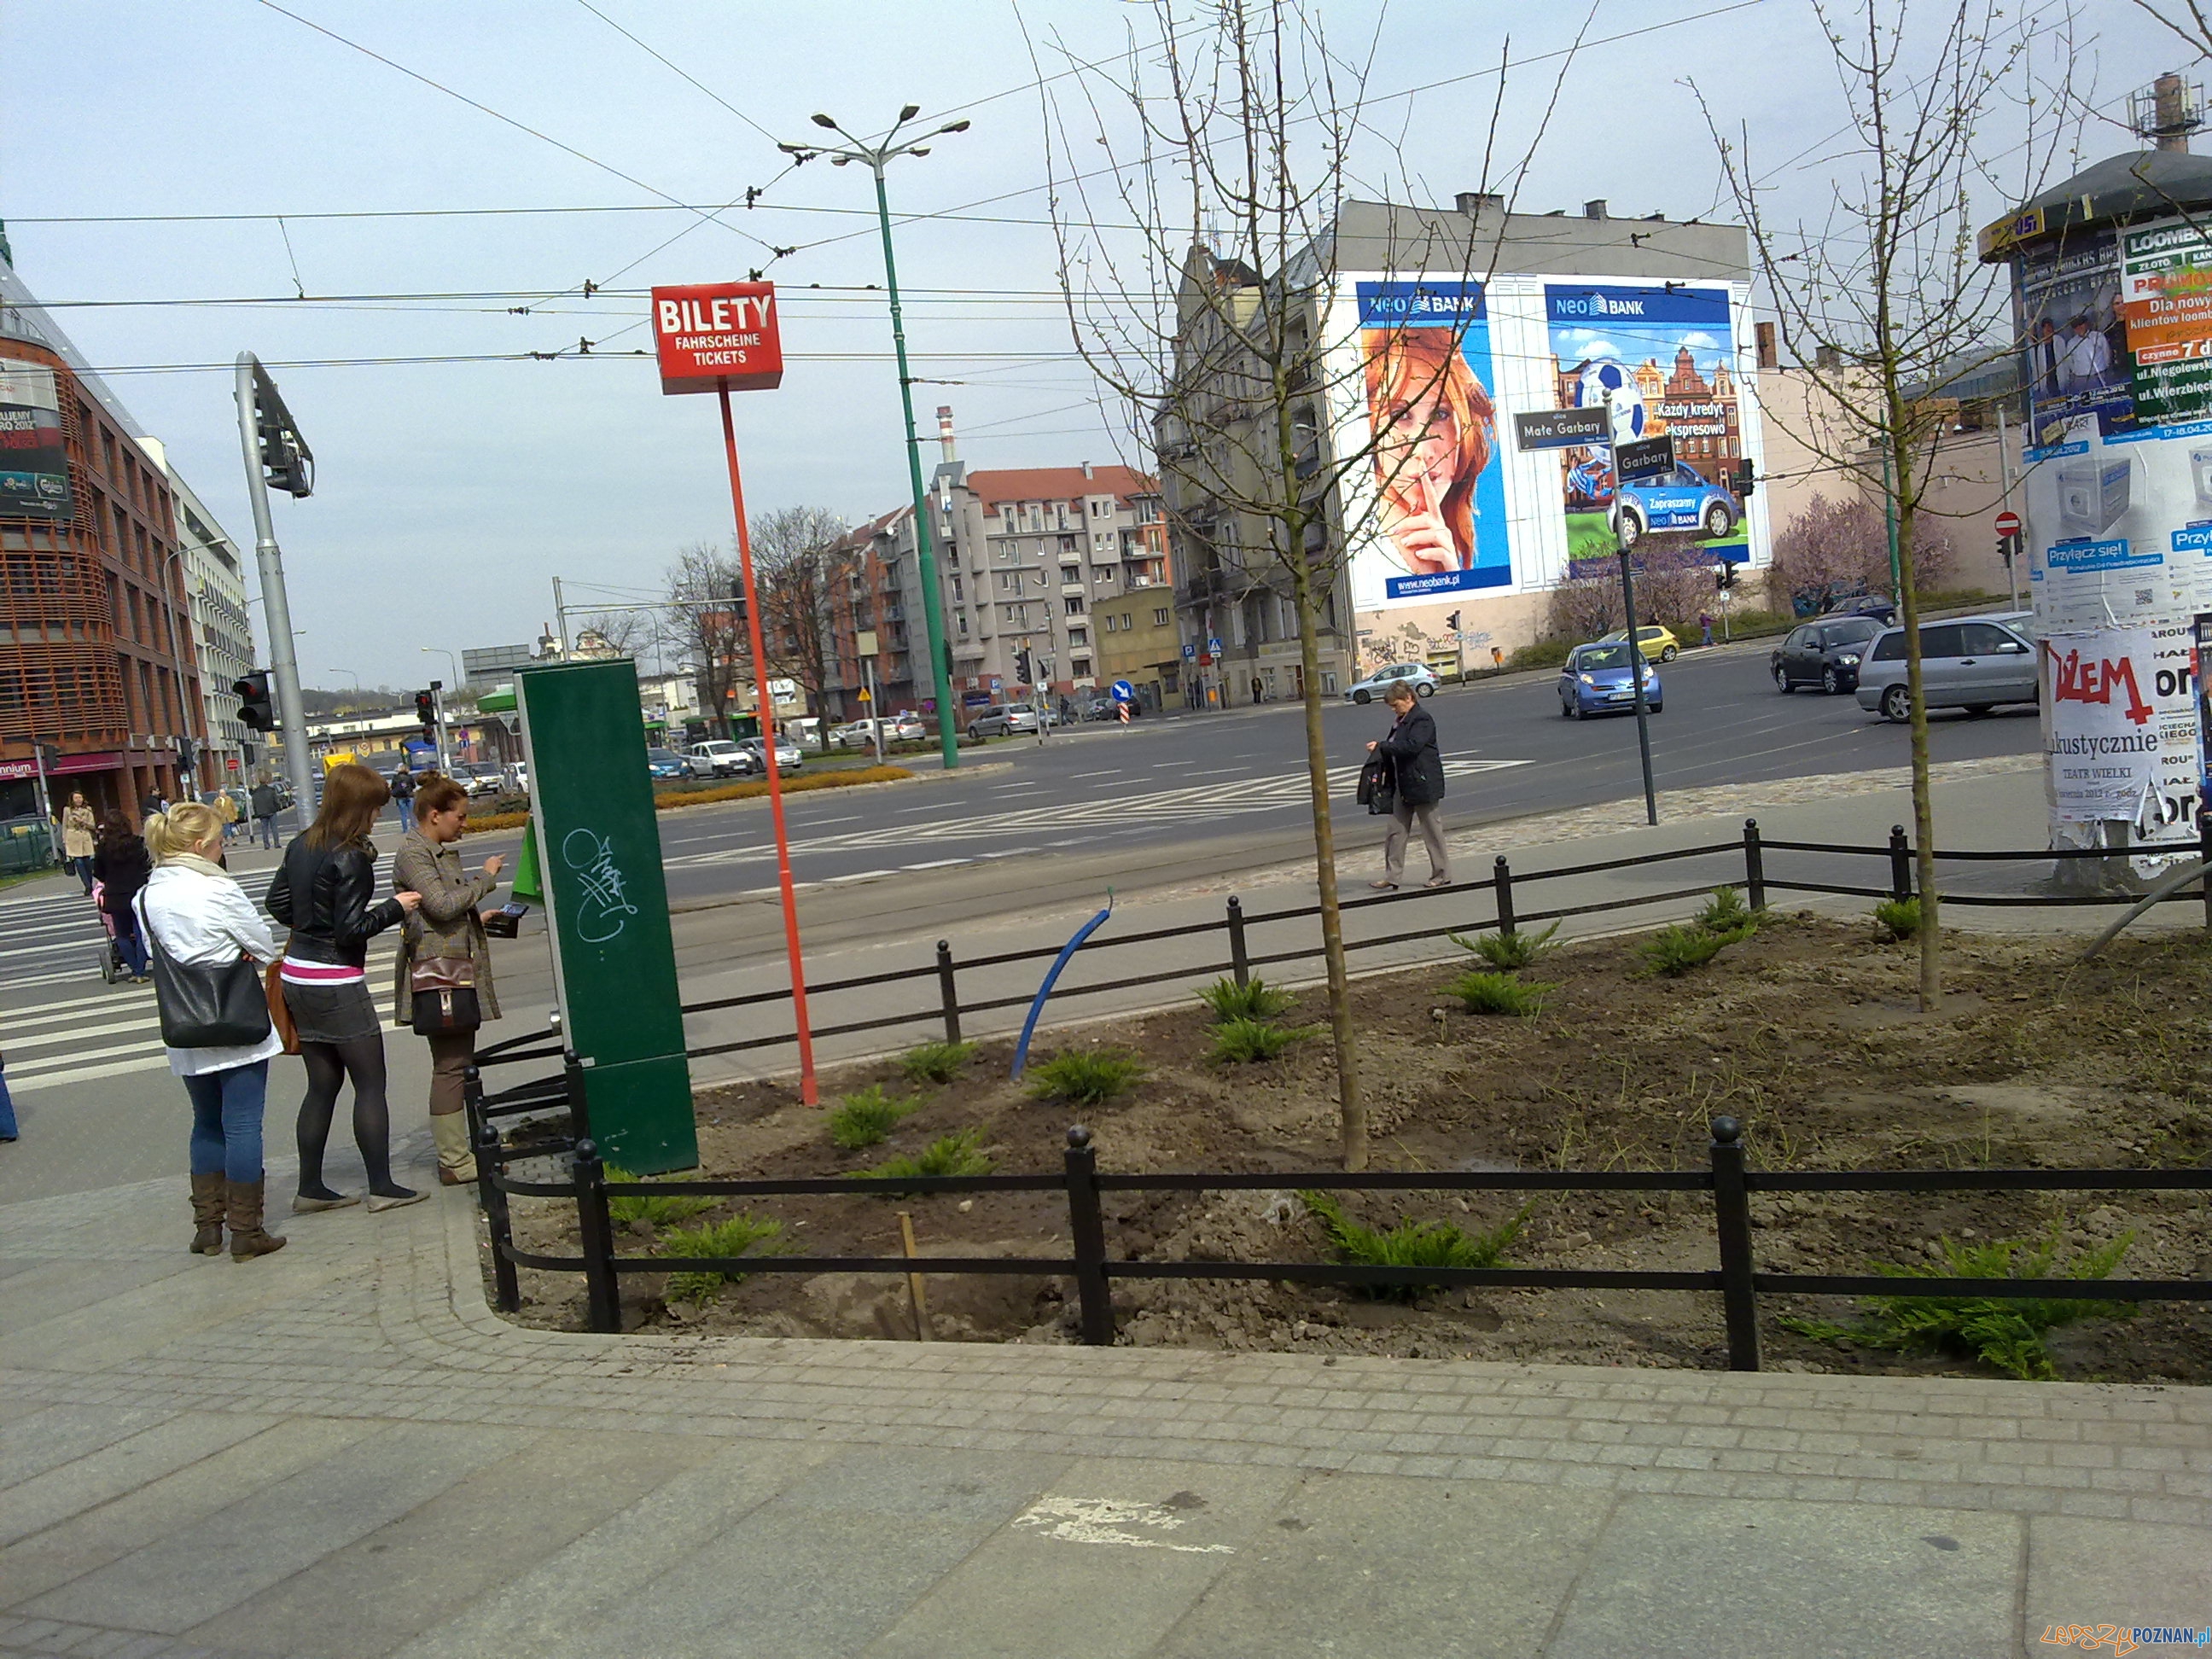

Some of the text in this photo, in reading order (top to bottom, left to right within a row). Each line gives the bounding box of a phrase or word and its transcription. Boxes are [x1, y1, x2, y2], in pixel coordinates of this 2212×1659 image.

[2139, 259, 2170, 271] ZŁOTO
[1433, 296, 1475, 312] BANK
[1609, 300, 1644, 315] BANK
[2150, 299, 2174, 313] Dla
[658, 294, 771, 334] BILETY
[675, 333, 761, 350] FAHRSCHEINE
[693, 350, 747, 366] TICKETS
[2182, 343, 2194, 357] 7
[1658, 401, 1724, 419] Każdy kredyt
[1557, 422, 1600, 434] Garbary
[1665, 422, 1725, 439] ekspresowo
[1622, 452, 1668, 469] Garbary
[1650, 498, 1696, 510] Zapraszamy
[1678, 515, 1697, 524] BANK
[2049, 542, 2122, 562] Przyłącz się!
[1397, 574, 1460, 591] www.neobank.pl
[2064, 767, 2132, 779] TEATR WIELKI
